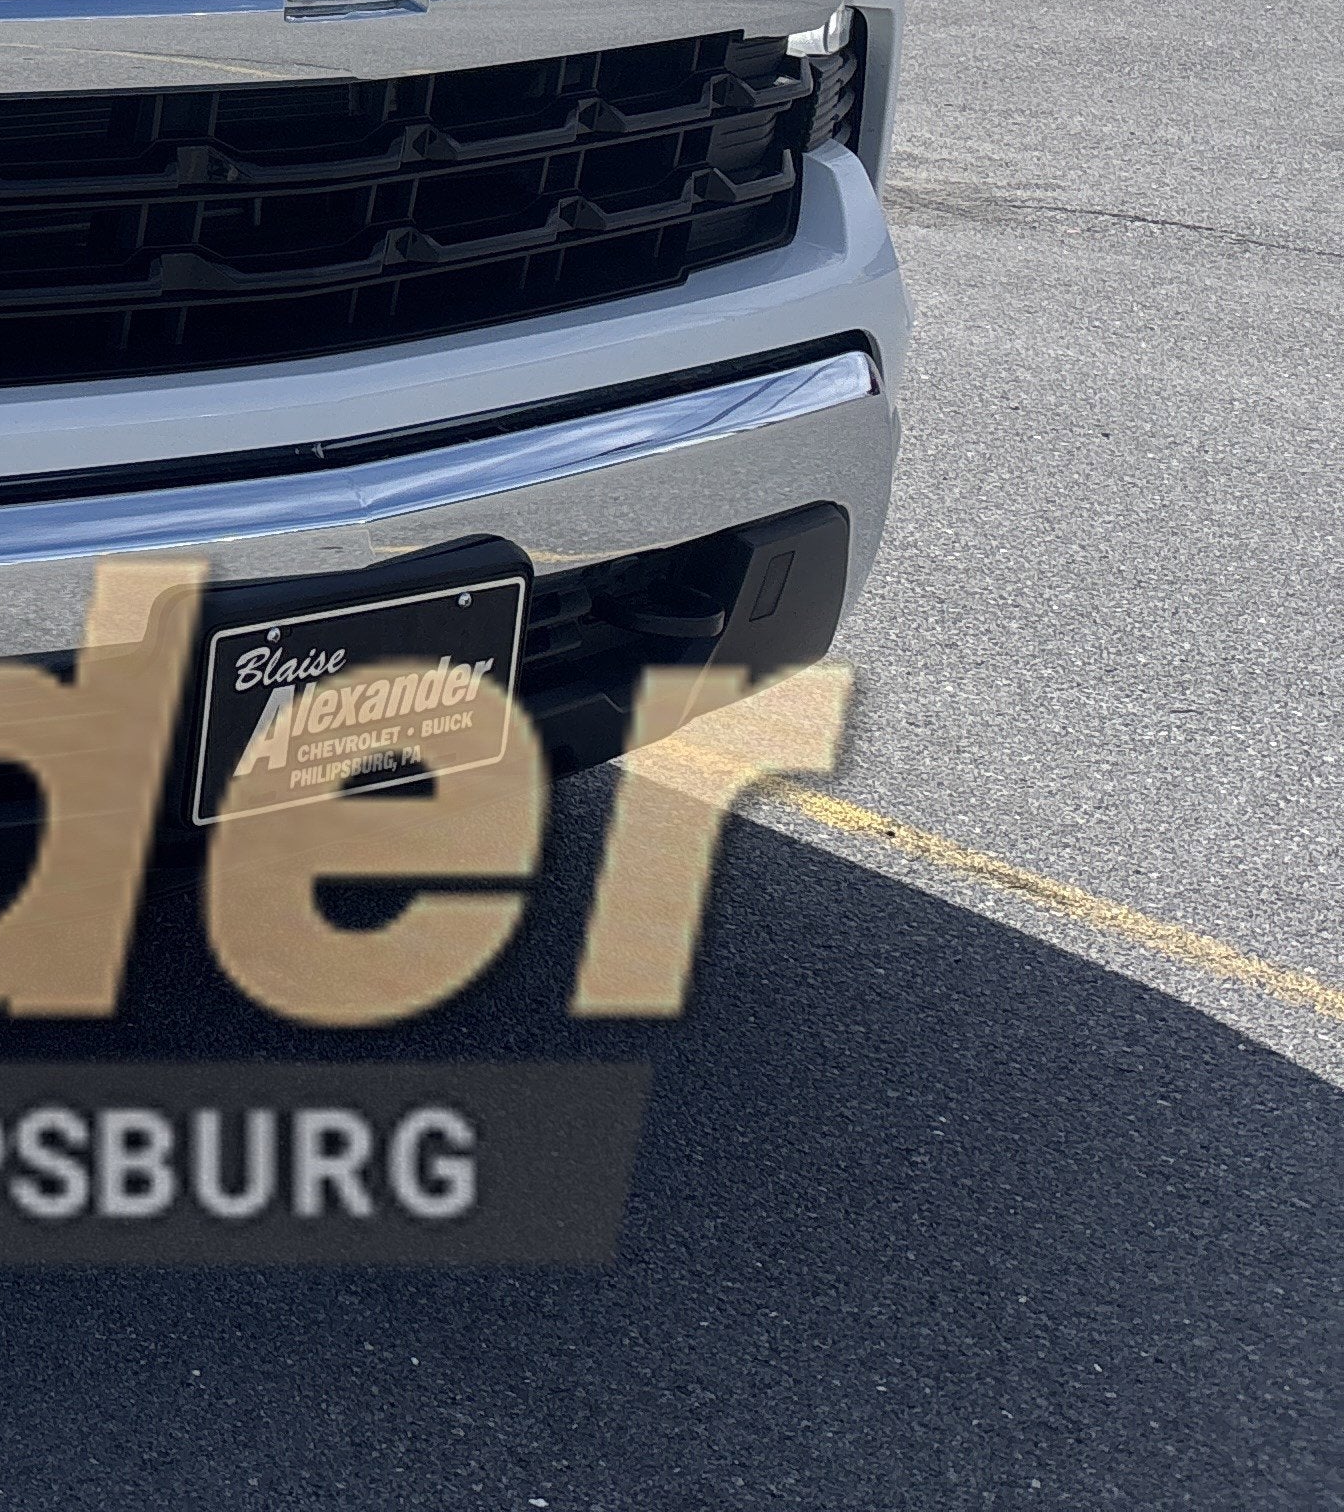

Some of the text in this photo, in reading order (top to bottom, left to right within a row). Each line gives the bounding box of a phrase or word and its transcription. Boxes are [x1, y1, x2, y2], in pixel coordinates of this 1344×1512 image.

[235, 646, 346, 692] Blaise
[233, 656, 494, 778] Alexander
[297, 711, 474, 764] CHEVROLET BUICK
[290, 745, 423, 789] PHILIPSBURG, PA
